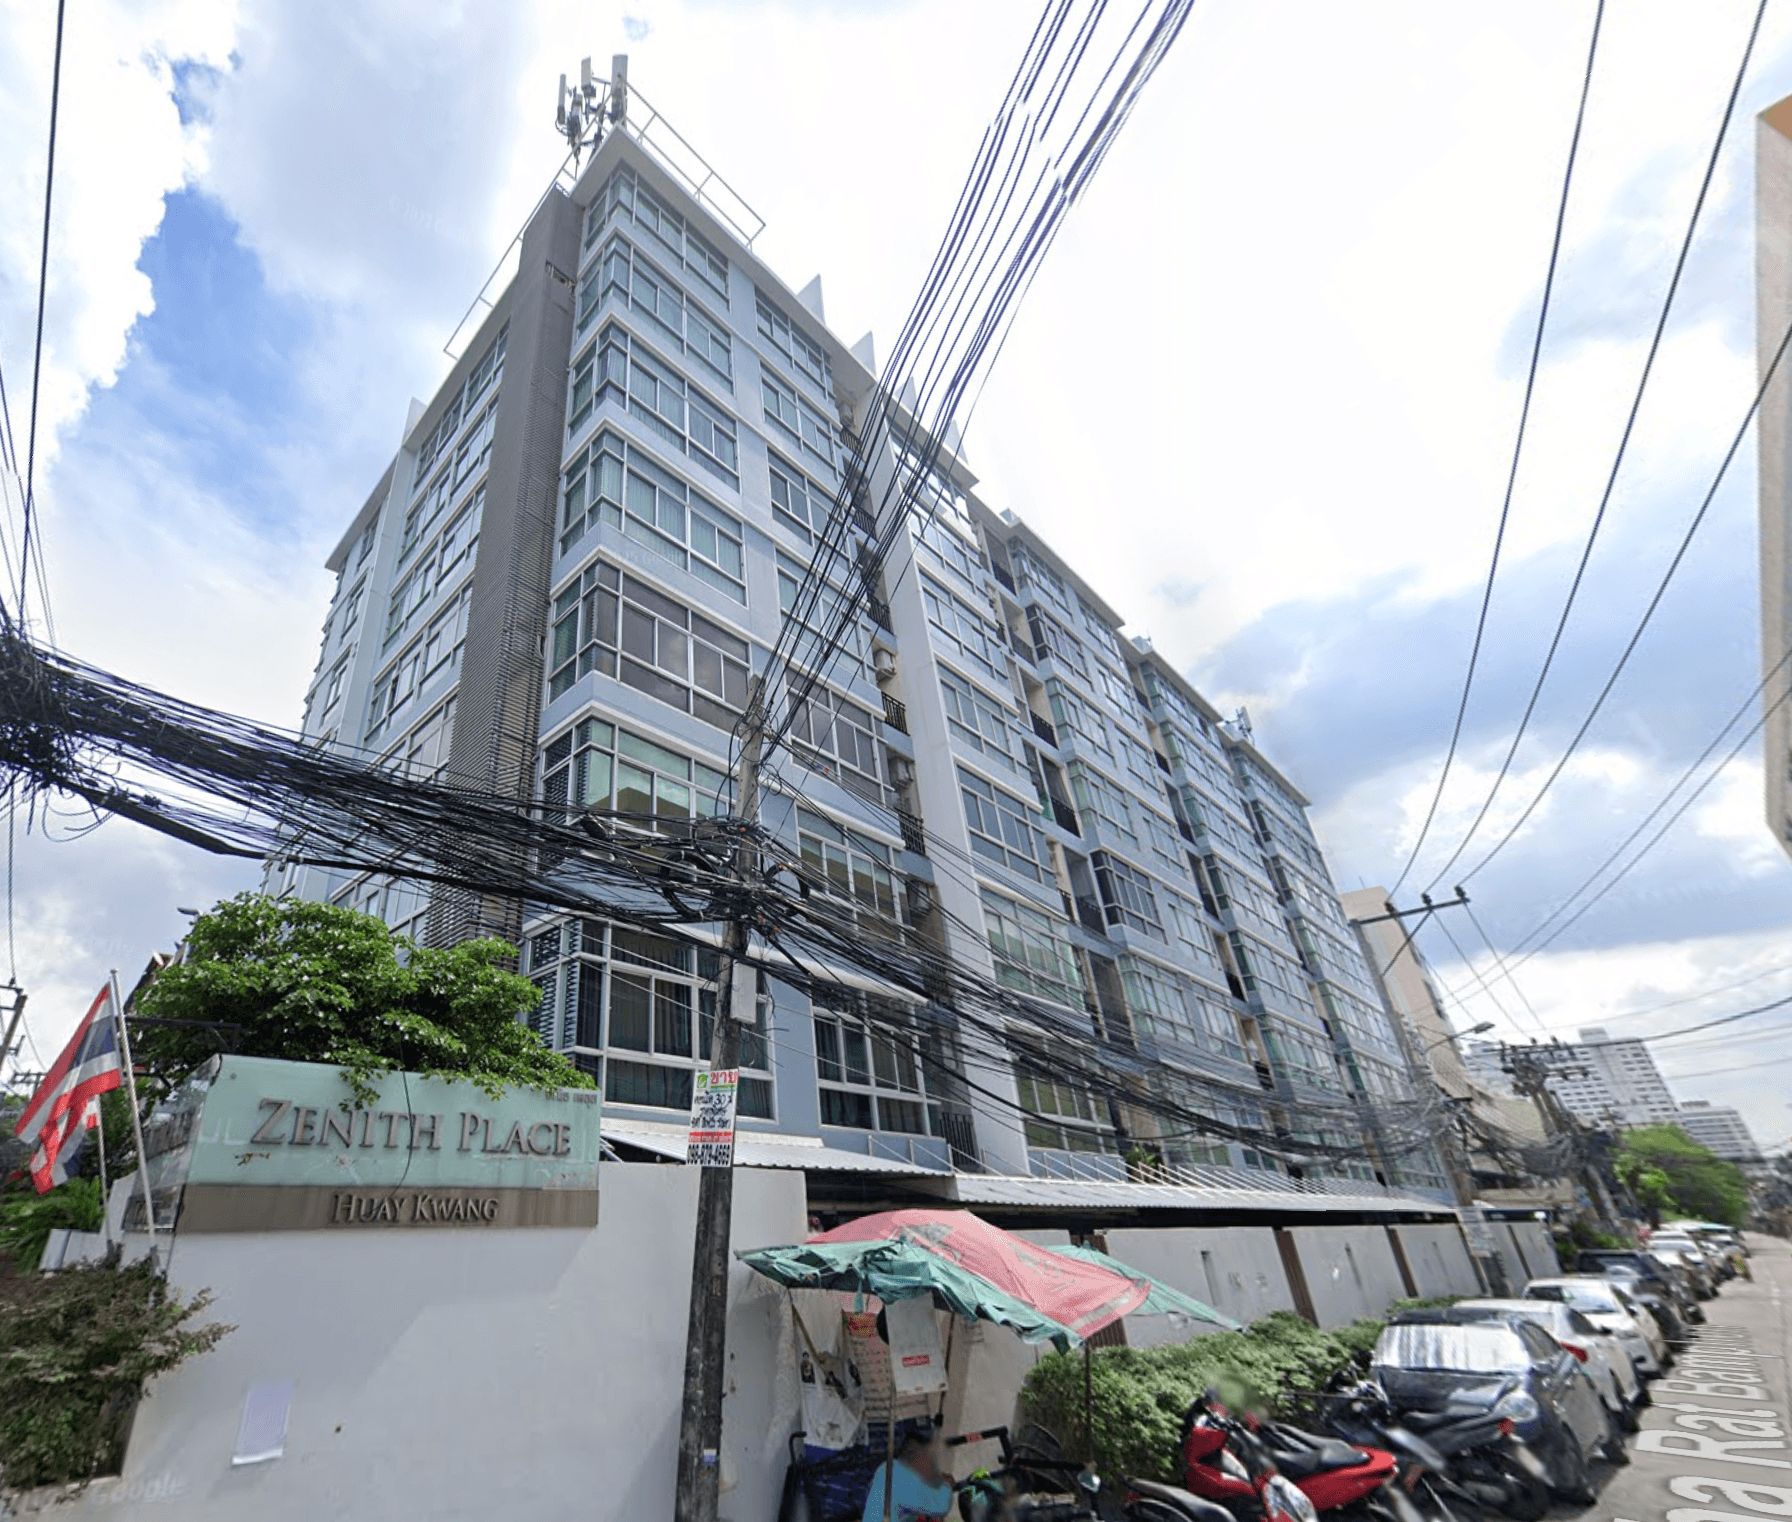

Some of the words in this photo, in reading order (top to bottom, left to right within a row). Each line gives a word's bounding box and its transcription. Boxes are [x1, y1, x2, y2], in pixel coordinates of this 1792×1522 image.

[250, 1099, 441, 1151] ZENITH
[457, 1111, 572, 1156] PLACE
[332, 1193, 405, 1222] HUAY
[410, 1195, 499, 1225] KWANG
